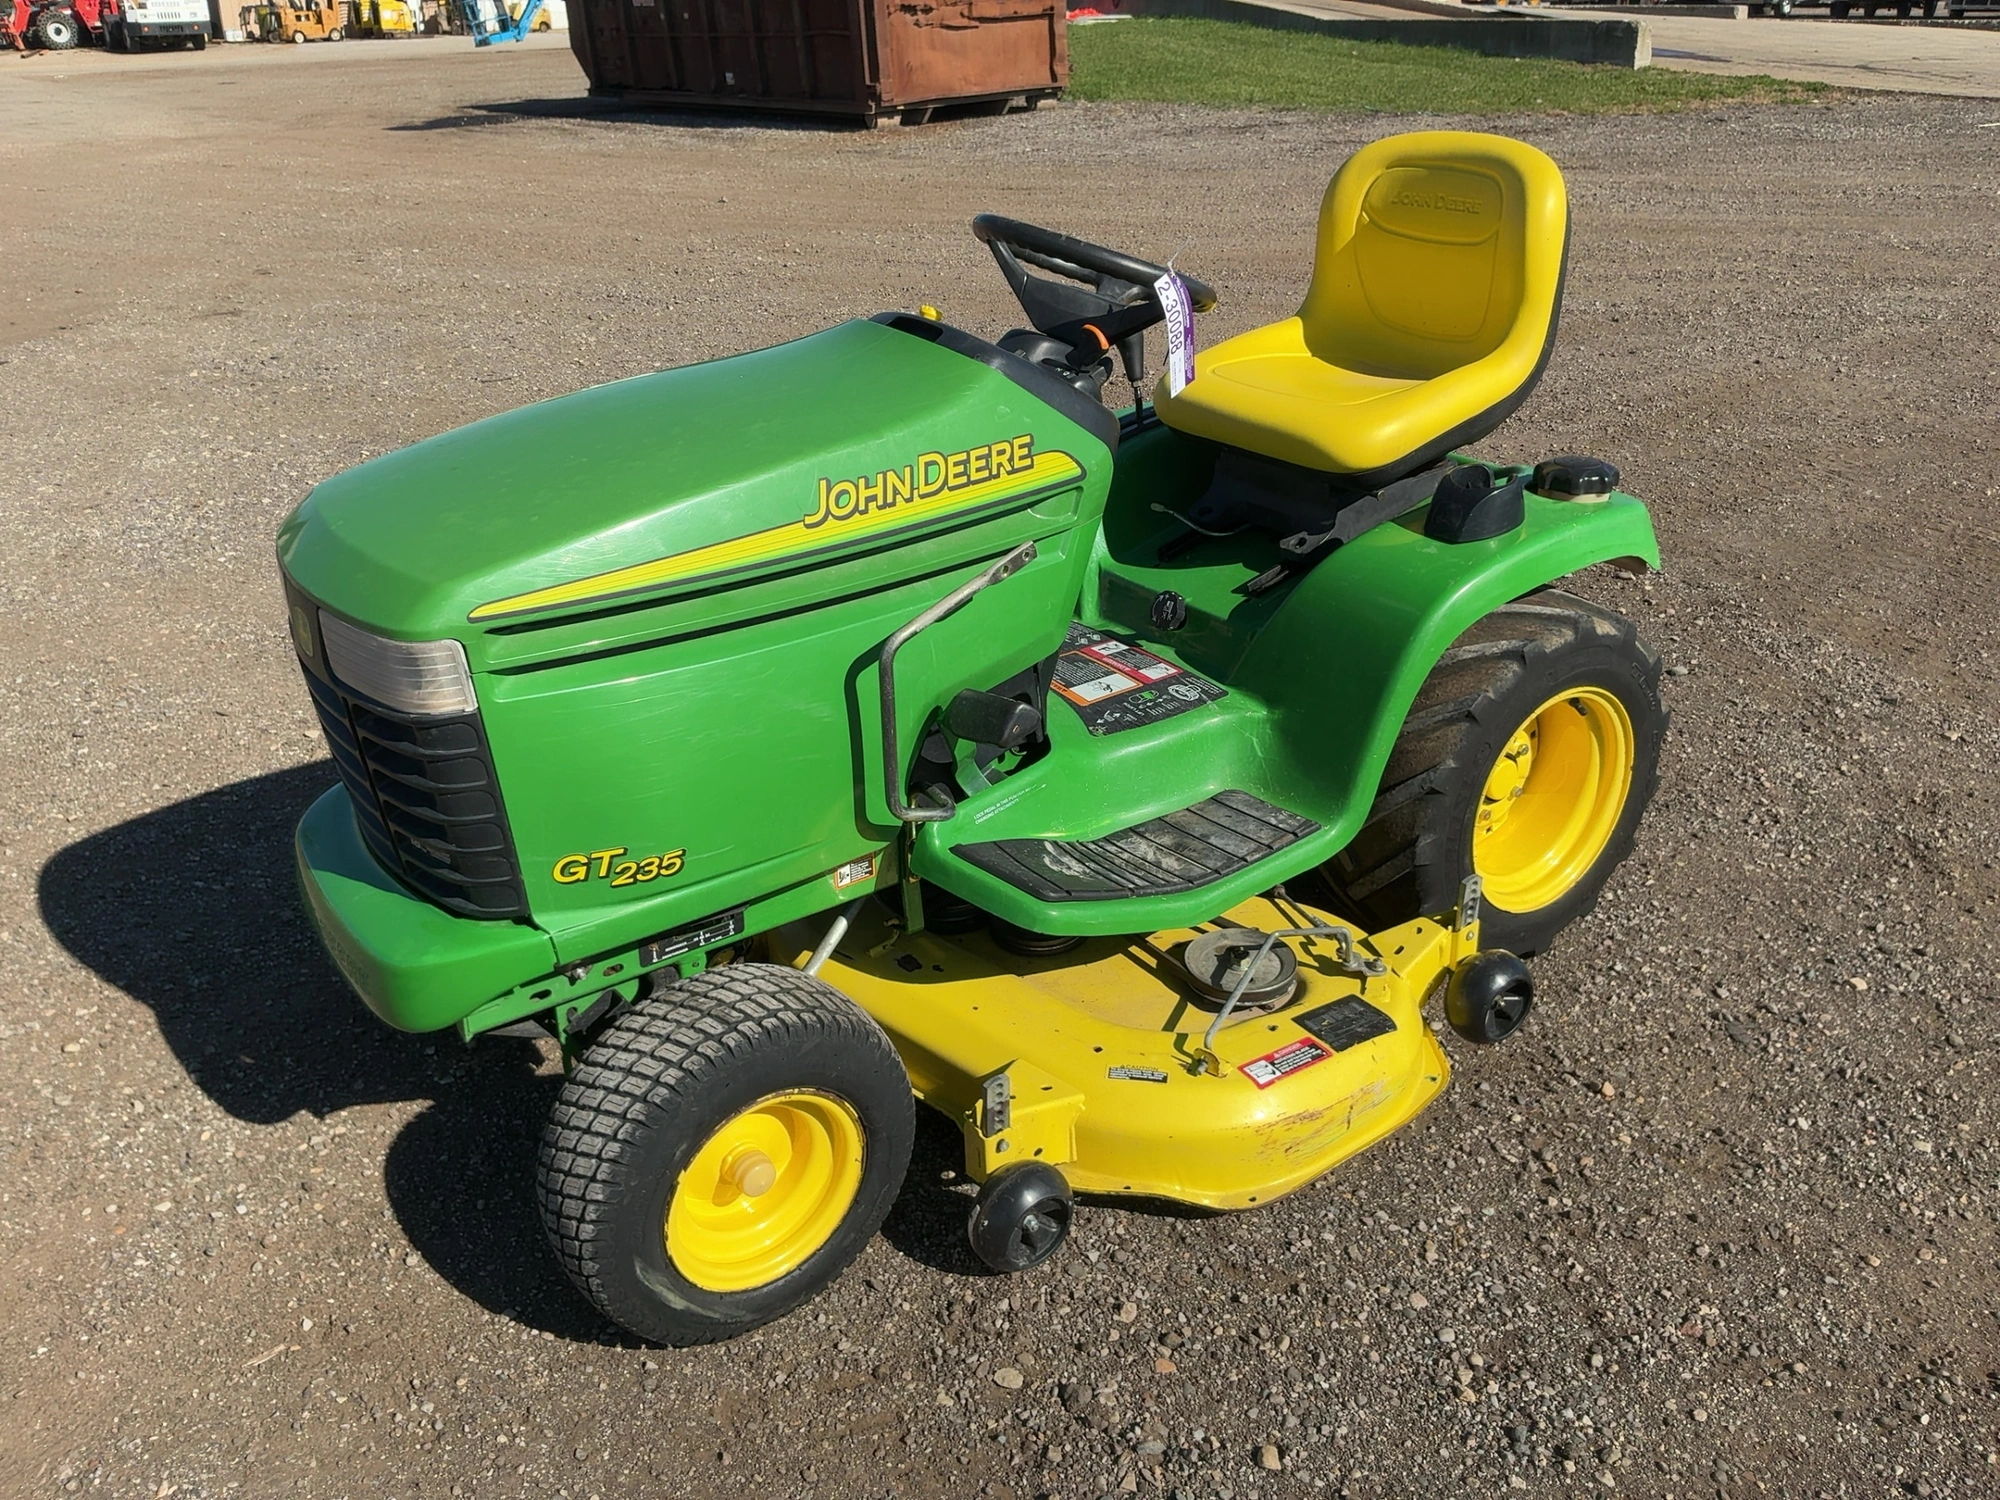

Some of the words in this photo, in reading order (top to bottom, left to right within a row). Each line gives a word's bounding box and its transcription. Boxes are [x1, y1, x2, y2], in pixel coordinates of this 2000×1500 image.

[1391, 191, 1431, 208] JOHN
[1434, 192, 1482, 215] DEERE
[1158, 281, 1183, 355] 2-30088
[803, 465, 913, 529] JOHN
[917, 434, 1034, 498] DEERE
